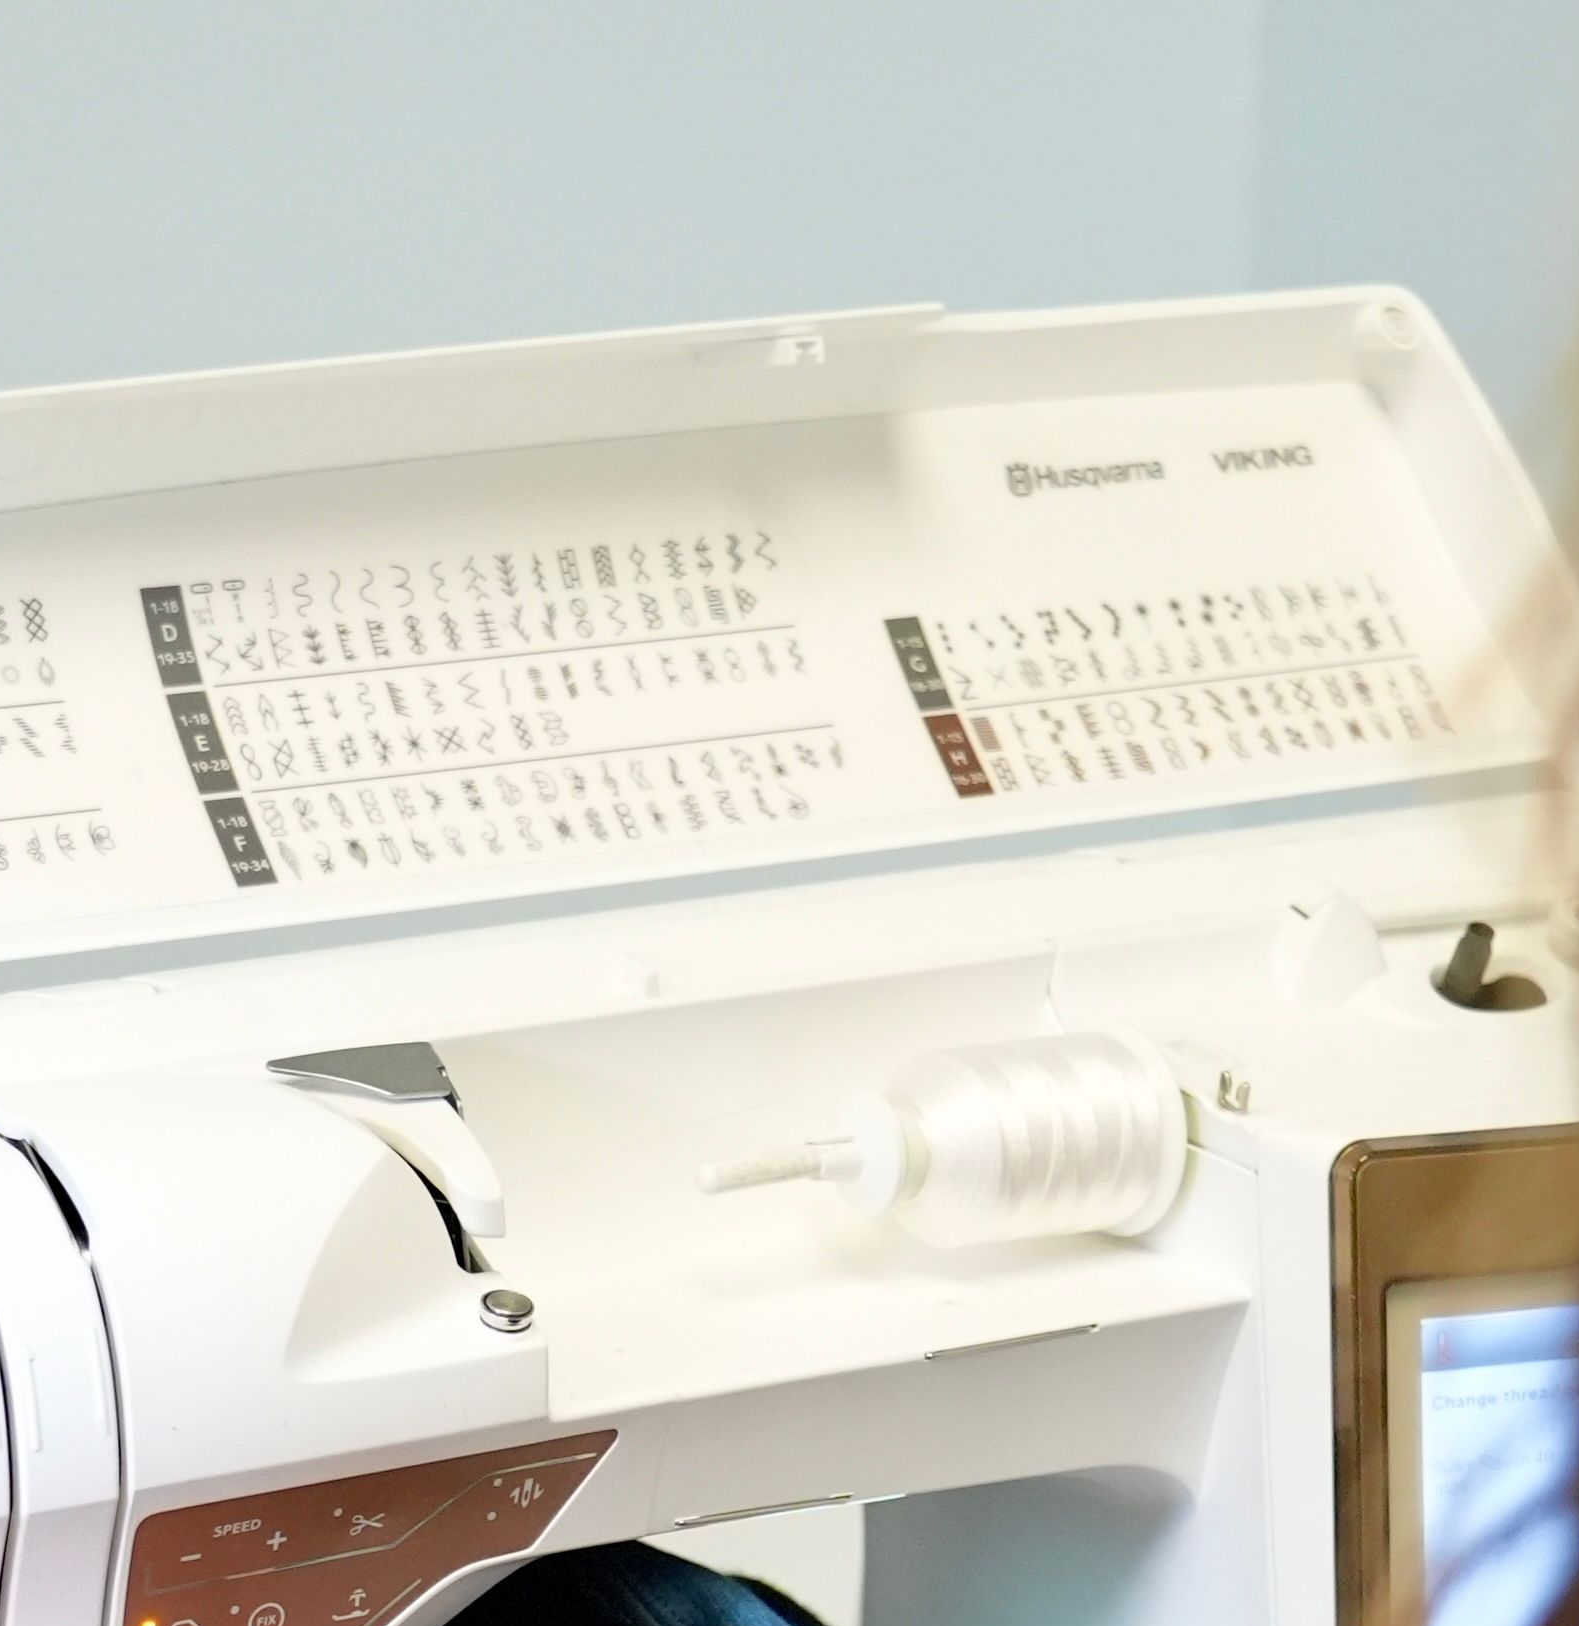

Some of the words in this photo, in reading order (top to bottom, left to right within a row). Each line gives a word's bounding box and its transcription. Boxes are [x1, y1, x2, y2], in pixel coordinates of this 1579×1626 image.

[1033, 461, 1165, 490] Husqvarna
[1212, 445, 1313, 473] VIKING
[150, 601, 180, 615] 1-18
[160, 624, 178, 643] D
[157, 651, 195, 667] 19-35
[179, 713, 211, 727] 1-18
[193, 735, 211, 752] E
[192, 759, 230, 774] 19-28
[217, 816, 248, 829] 1-18
[233, 836, 247, 852] F
[232, 859, 270, 874] 19-34
[1432, 1394, 1497, 1411] Change
[213, 1519, 261, 1538] SPEED
